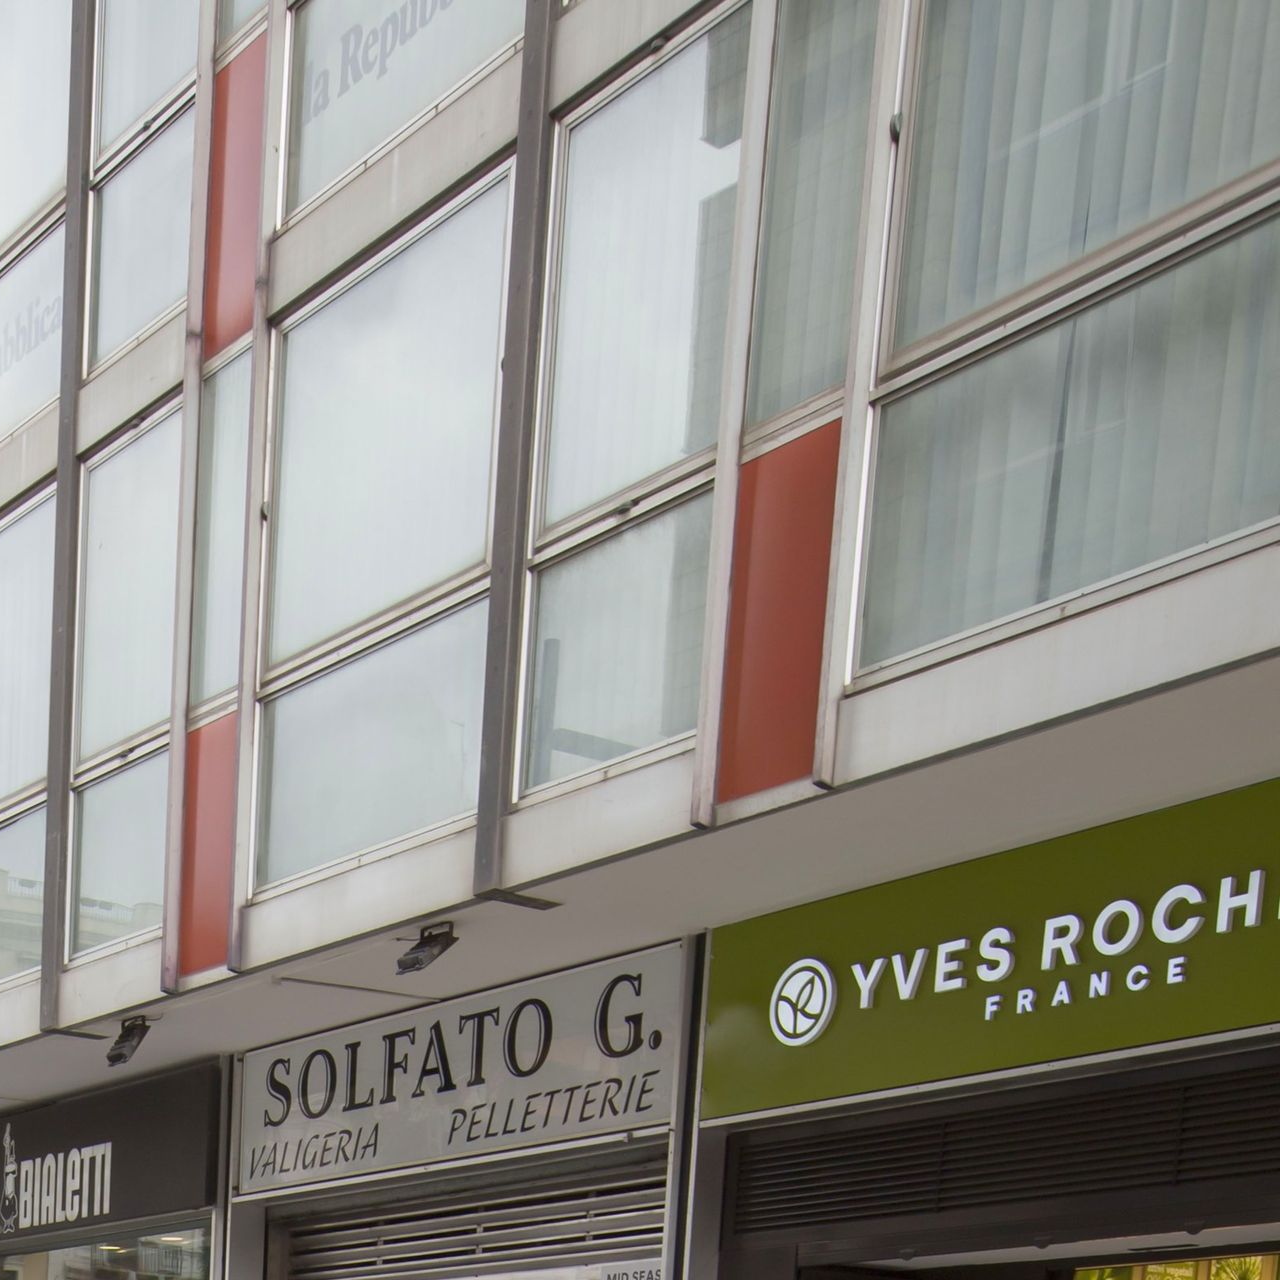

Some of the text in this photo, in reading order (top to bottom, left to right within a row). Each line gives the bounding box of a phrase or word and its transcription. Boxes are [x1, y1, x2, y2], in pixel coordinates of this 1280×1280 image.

[851, 868, 1280, 1010] YVES ROCH
[984, 955, 1188, 1022] FRANCE
[263, 972, 663, 1128] SOLFATO G.
[248, 1069, 661, 1181] VALIGERIA PELLETTERIE
